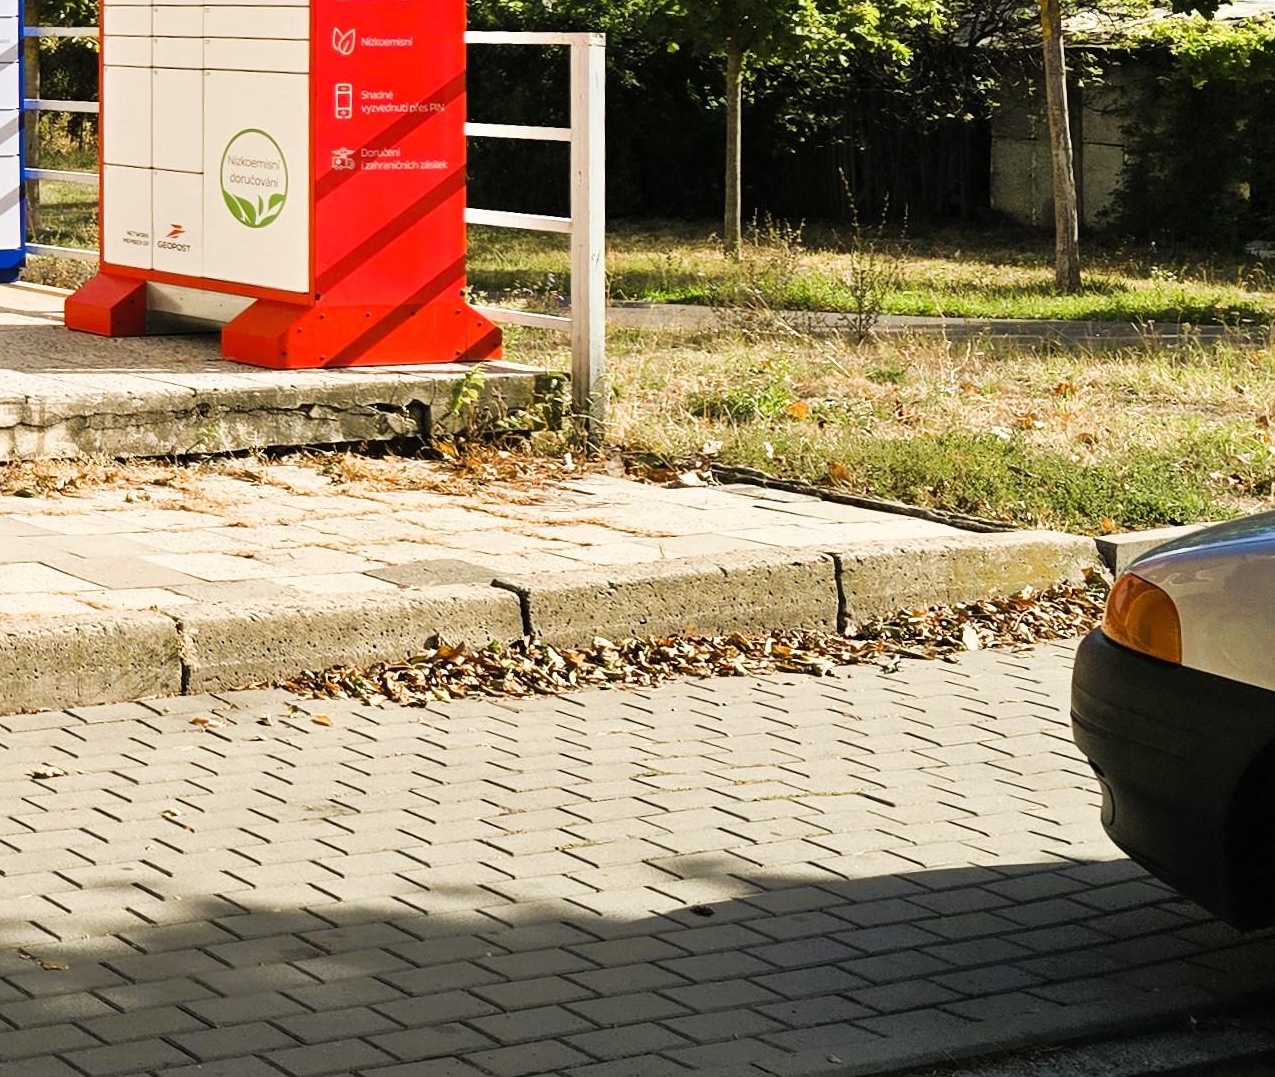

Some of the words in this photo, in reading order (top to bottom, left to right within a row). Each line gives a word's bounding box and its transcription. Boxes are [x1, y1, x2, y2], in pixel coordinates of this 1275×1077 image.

[361, 90, 394, 100] Snadné
[361, 103, 409, 114] vyzvednutí
[409, 103, 428, 114] přes
[429, 103, 445, 112] PIN
[361, 148, 401, 157] Doručení
[229, 174, 279, 187] doručování
[157, 240, 191, 252] GEOPOST
